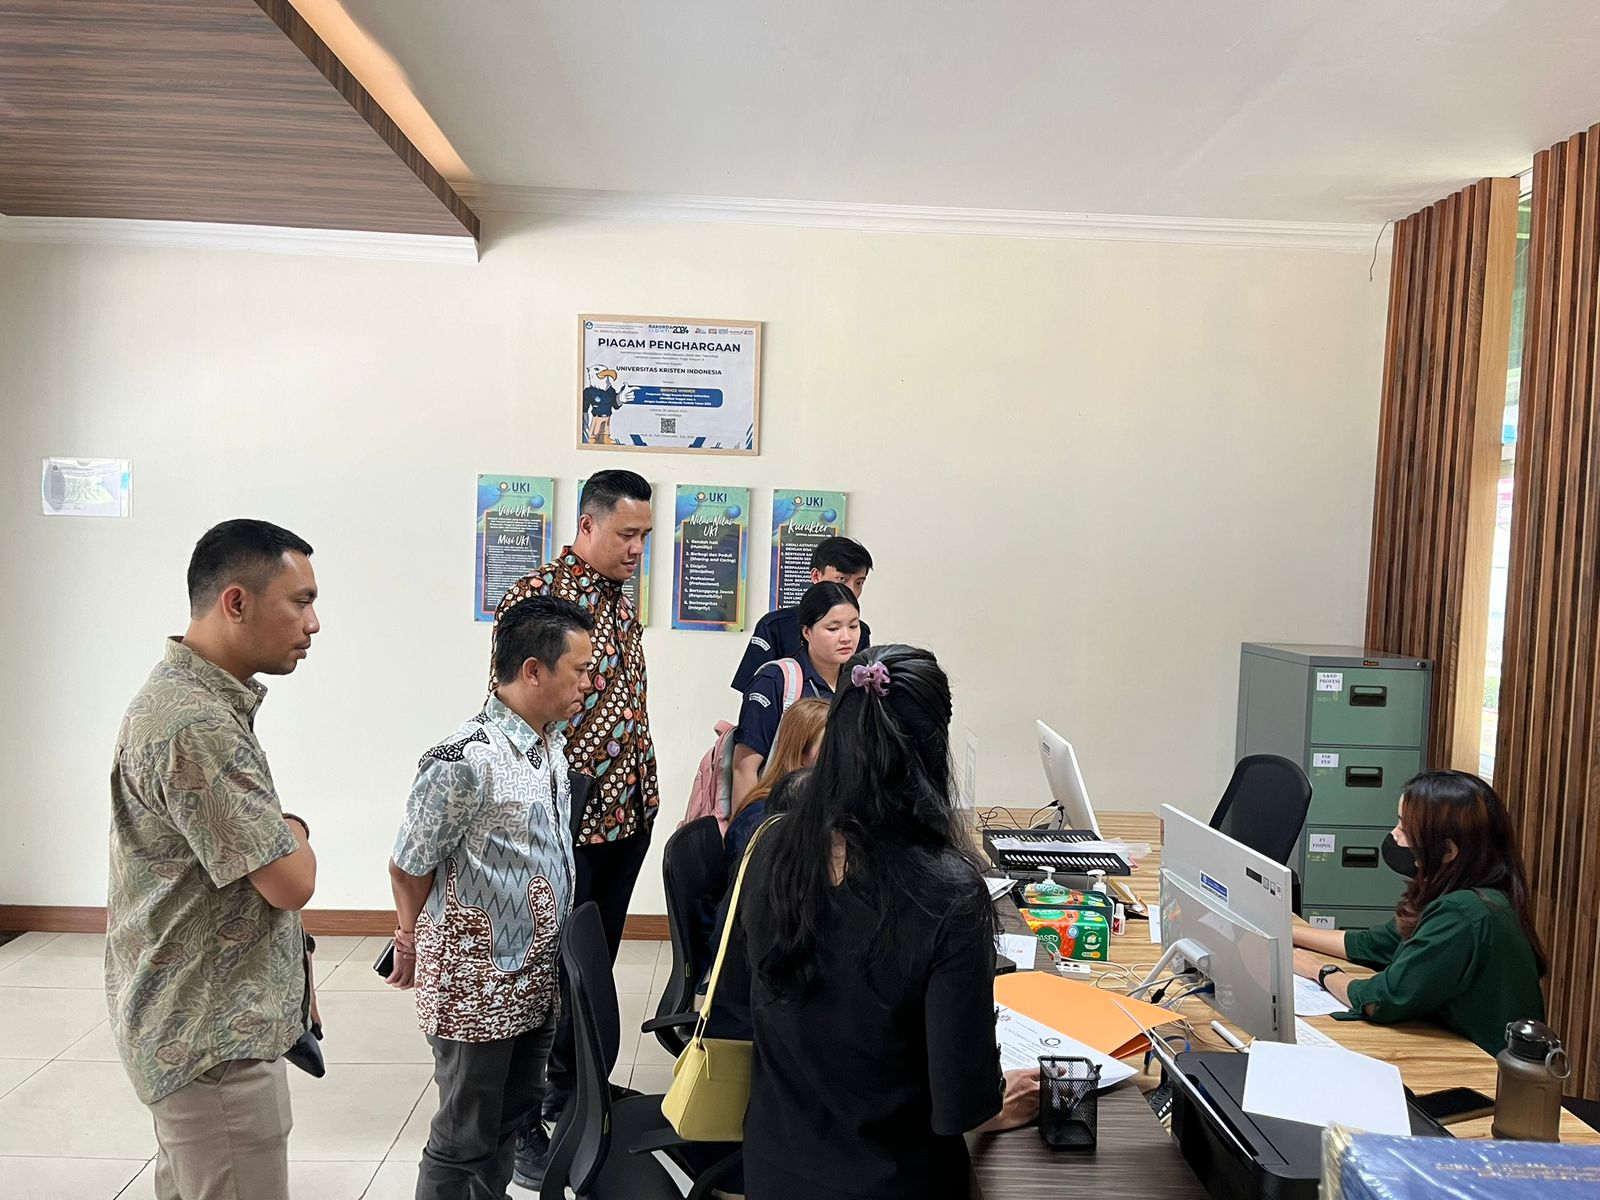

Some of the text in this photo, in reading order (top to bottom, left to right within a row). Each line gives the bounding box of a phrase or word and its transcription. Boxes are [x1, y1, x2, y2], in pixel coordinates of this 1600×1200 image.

[672, 325, 690, 334] 2024
[598, 337, 741, 353] PIAGAM PENGHARGAAN
[512, 482, 530, 493] UKI
[709, 492, 727, 503] UKI
[805, 496, 824, 507] UKI
[498, 504, 531, 518] Visi UKI
[703, 525, 719, 537] UKI
[787, 518, 828, 535] Karakter
[497, 534, 530, 547] Misi UKI
